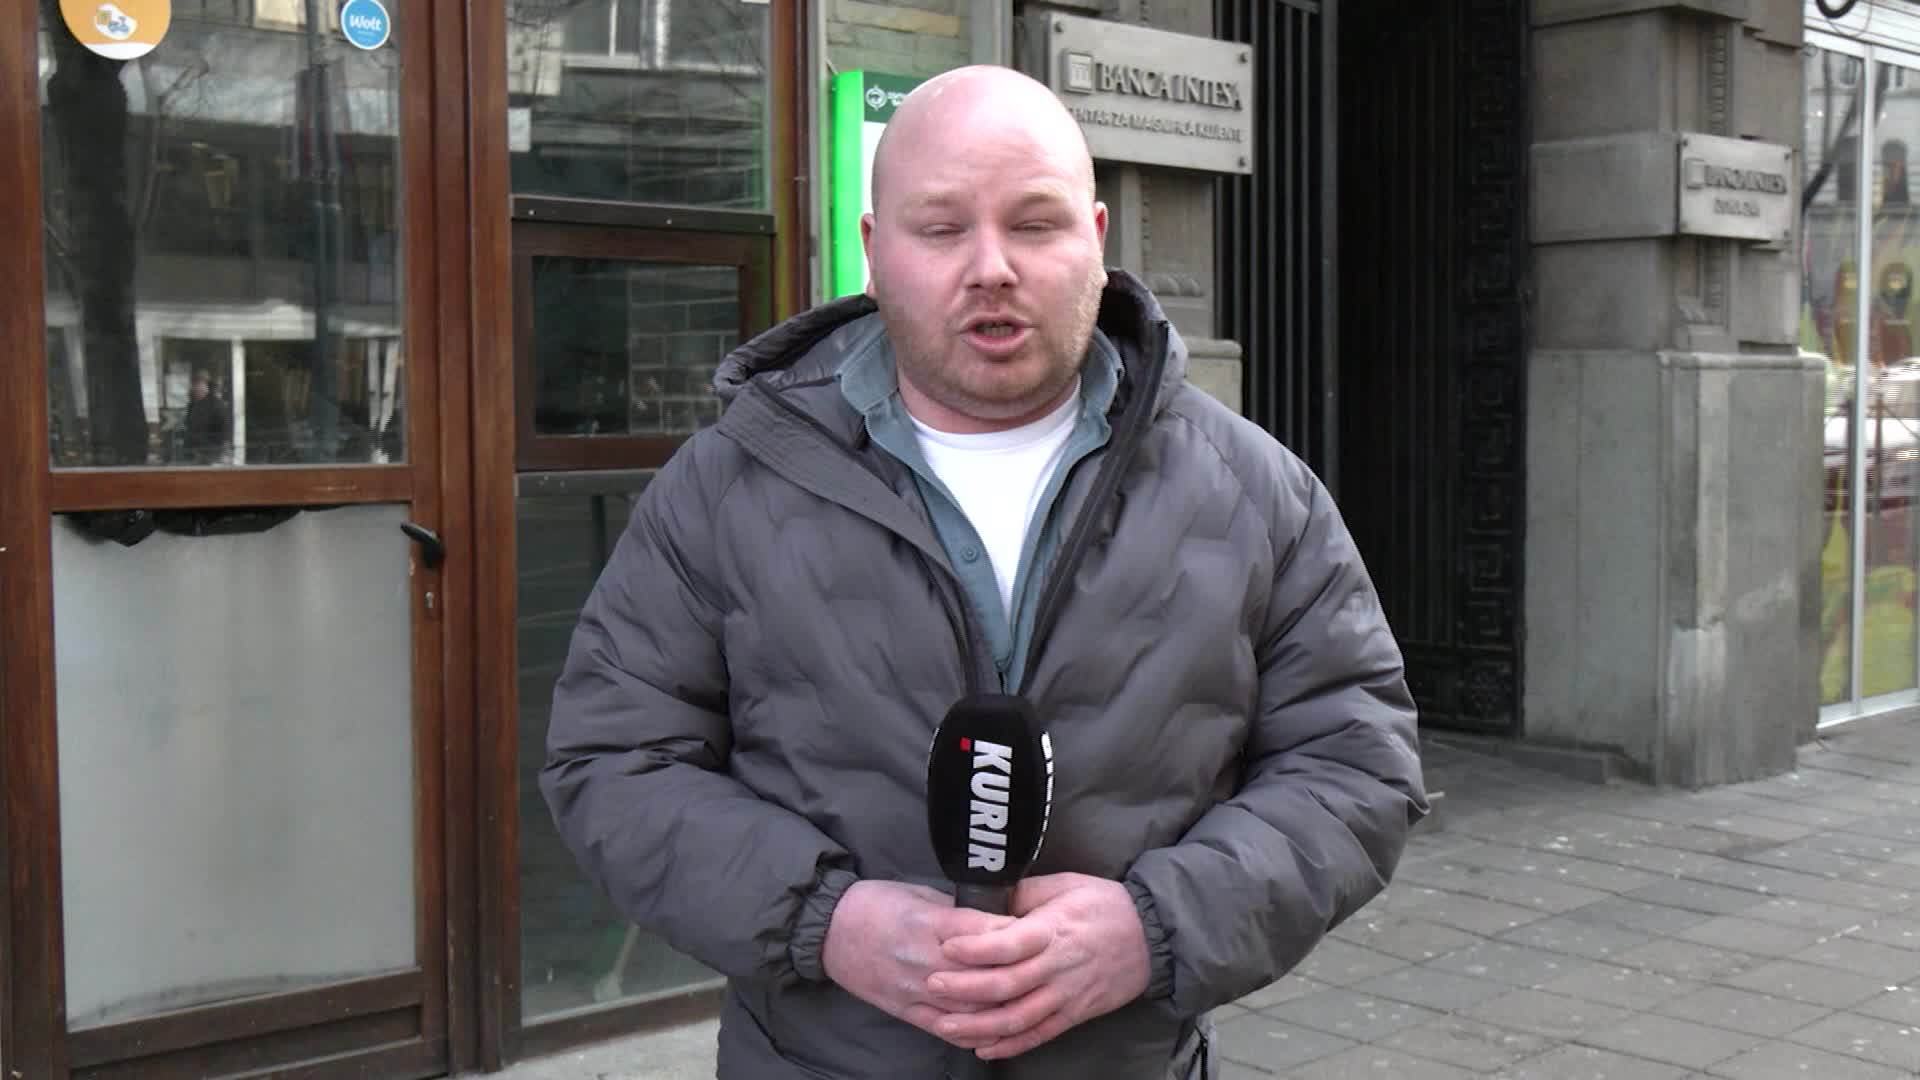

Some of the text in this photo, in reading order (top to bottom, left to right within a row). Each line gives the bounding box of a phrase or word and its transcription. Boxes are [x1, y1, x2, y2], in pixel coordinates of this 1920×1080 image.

[349, 15, 382, 31] Wolt
[1096, 63, 1243, 111] BANCA INTESA
[967, 739, 1013, 872] KURIR
